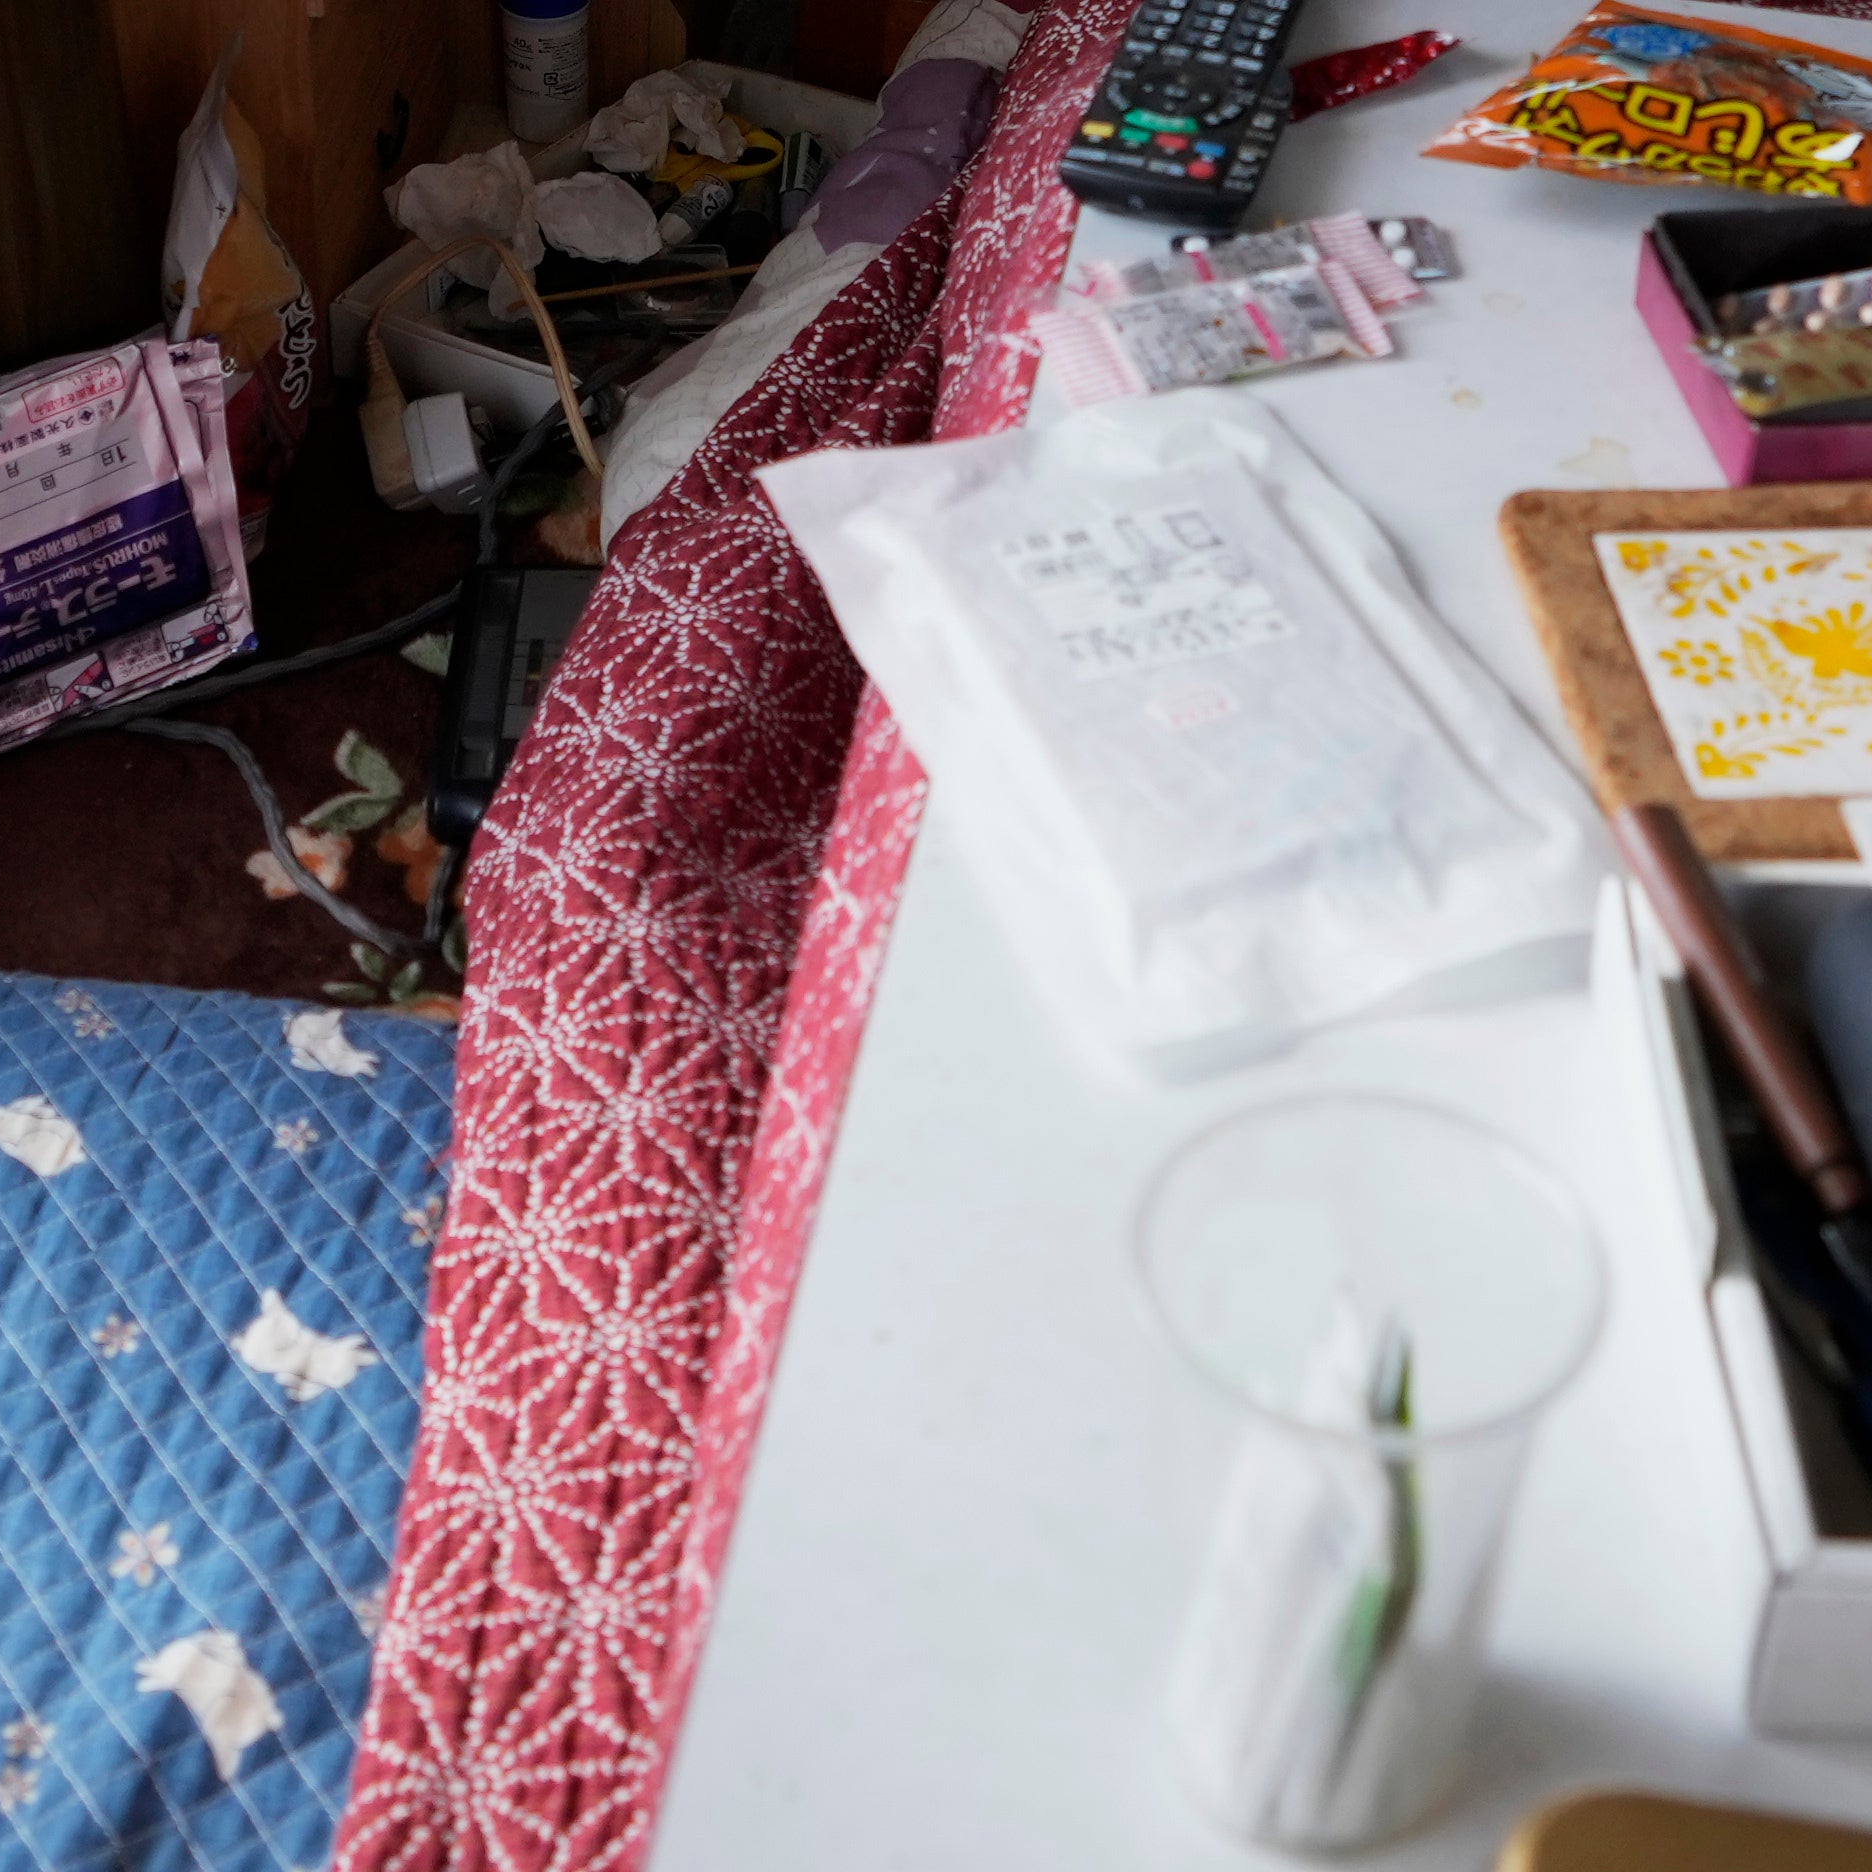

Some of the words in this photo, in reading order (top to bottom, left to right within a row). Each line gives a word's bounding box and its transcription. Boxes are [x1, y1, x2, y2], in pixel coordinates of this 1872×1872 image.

[54, 441, 73, 459] 年
[100, 444, 127, 468] 1日
[3, 460, 21, 479] 月
[39, 474, 56, 491] 回
[91, 531, 169, 575] MOHRUS
